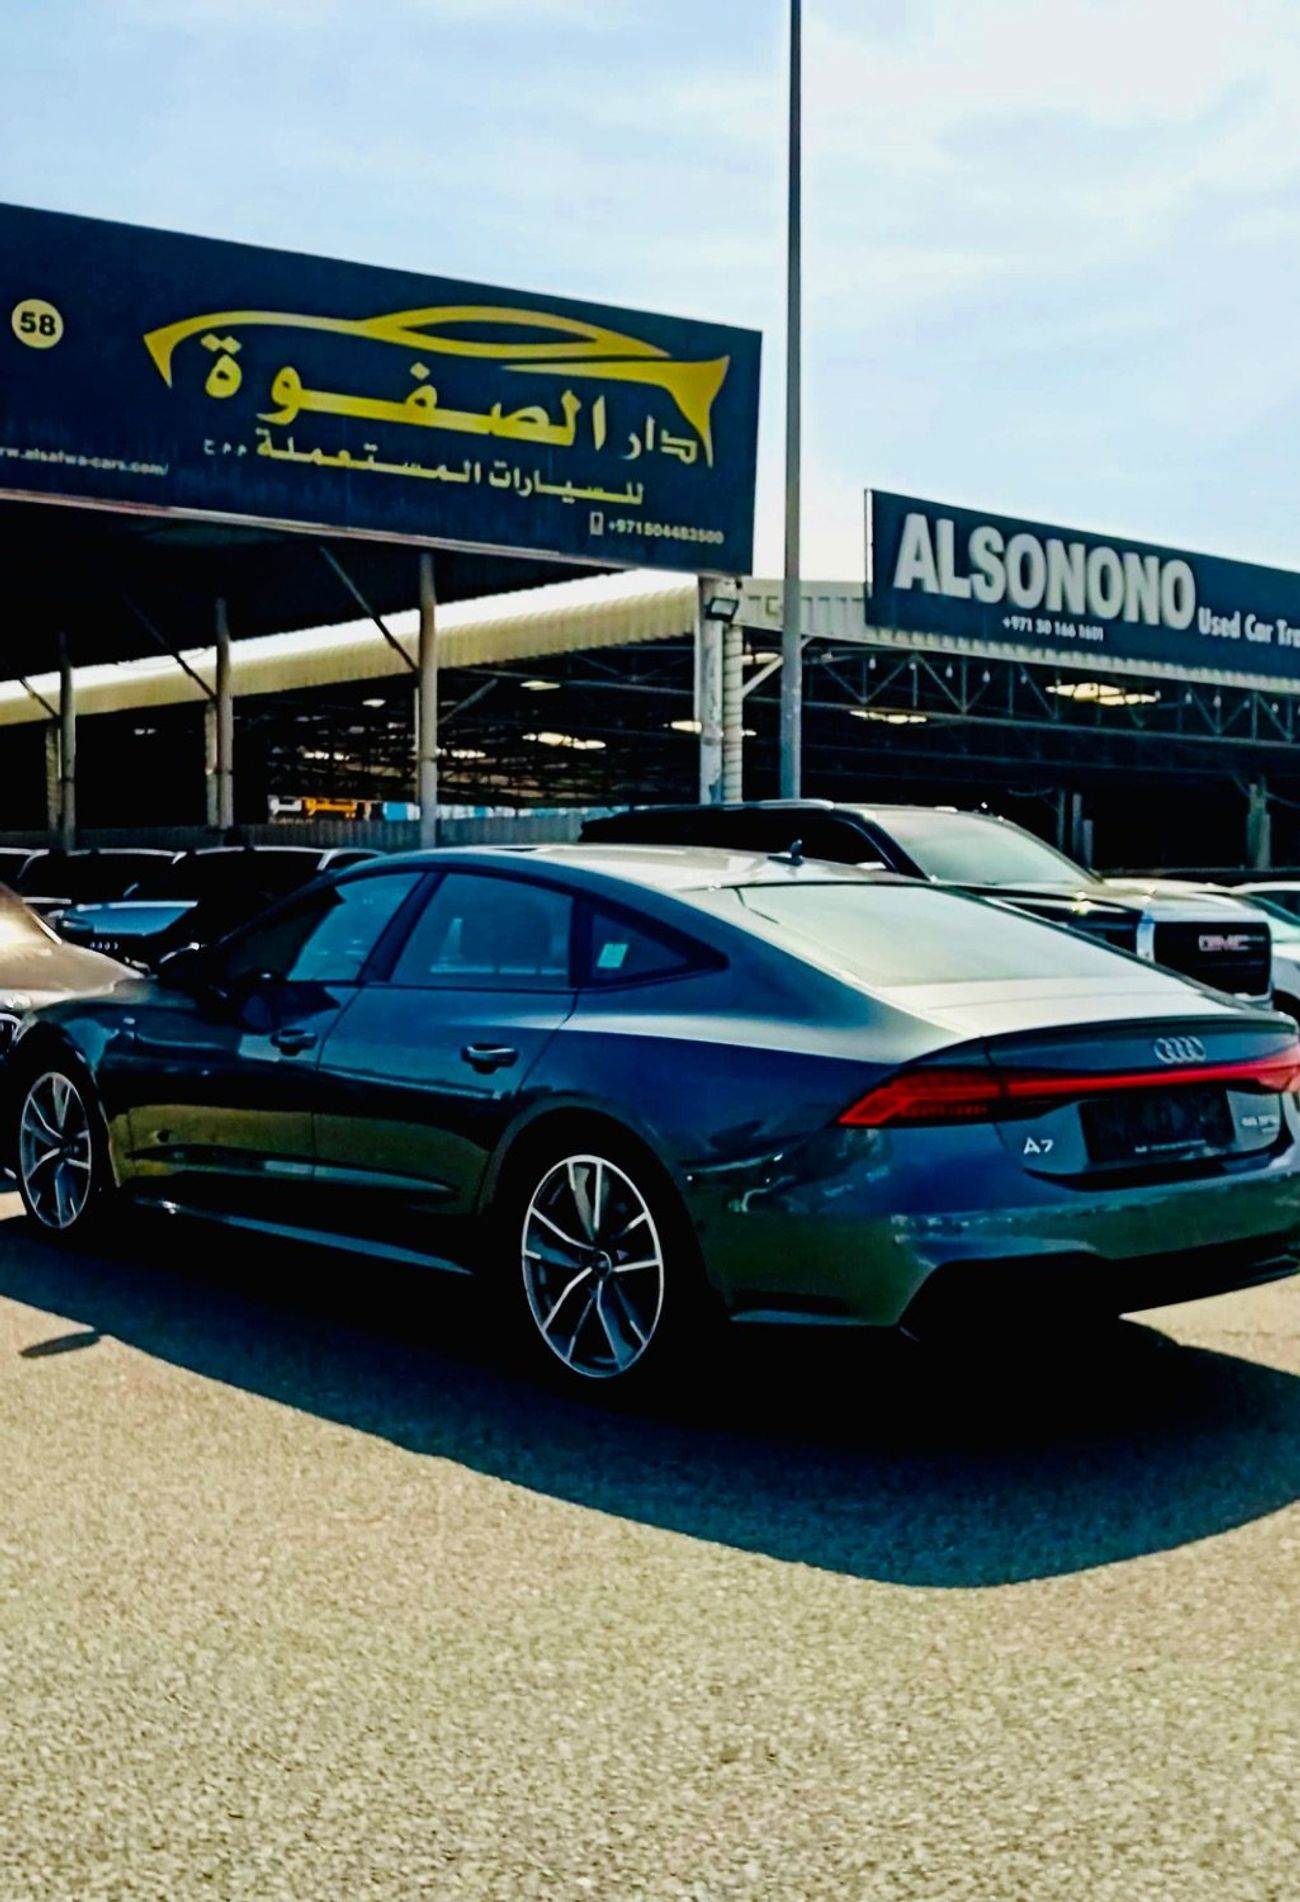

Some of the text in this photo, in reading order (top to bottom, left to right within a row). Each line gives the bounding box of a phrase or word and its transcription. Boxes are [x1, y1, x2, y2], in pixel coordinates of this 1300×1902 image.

[20, 310, 56, 337] 58
[201, 333, 698, 465] دار الصفوة
[256, 427, 481, 485] المستعملة
[489, 461, 644, 506] للسيارات
[893, 512, 1196, 631] ALSONONO
[1198, 605, 1241, 640] Used
[1244, 613, 1274, 645] Car
[1198, 934, 1251, 952] GMC
[1023, 1136, 1054, 1155] A7
